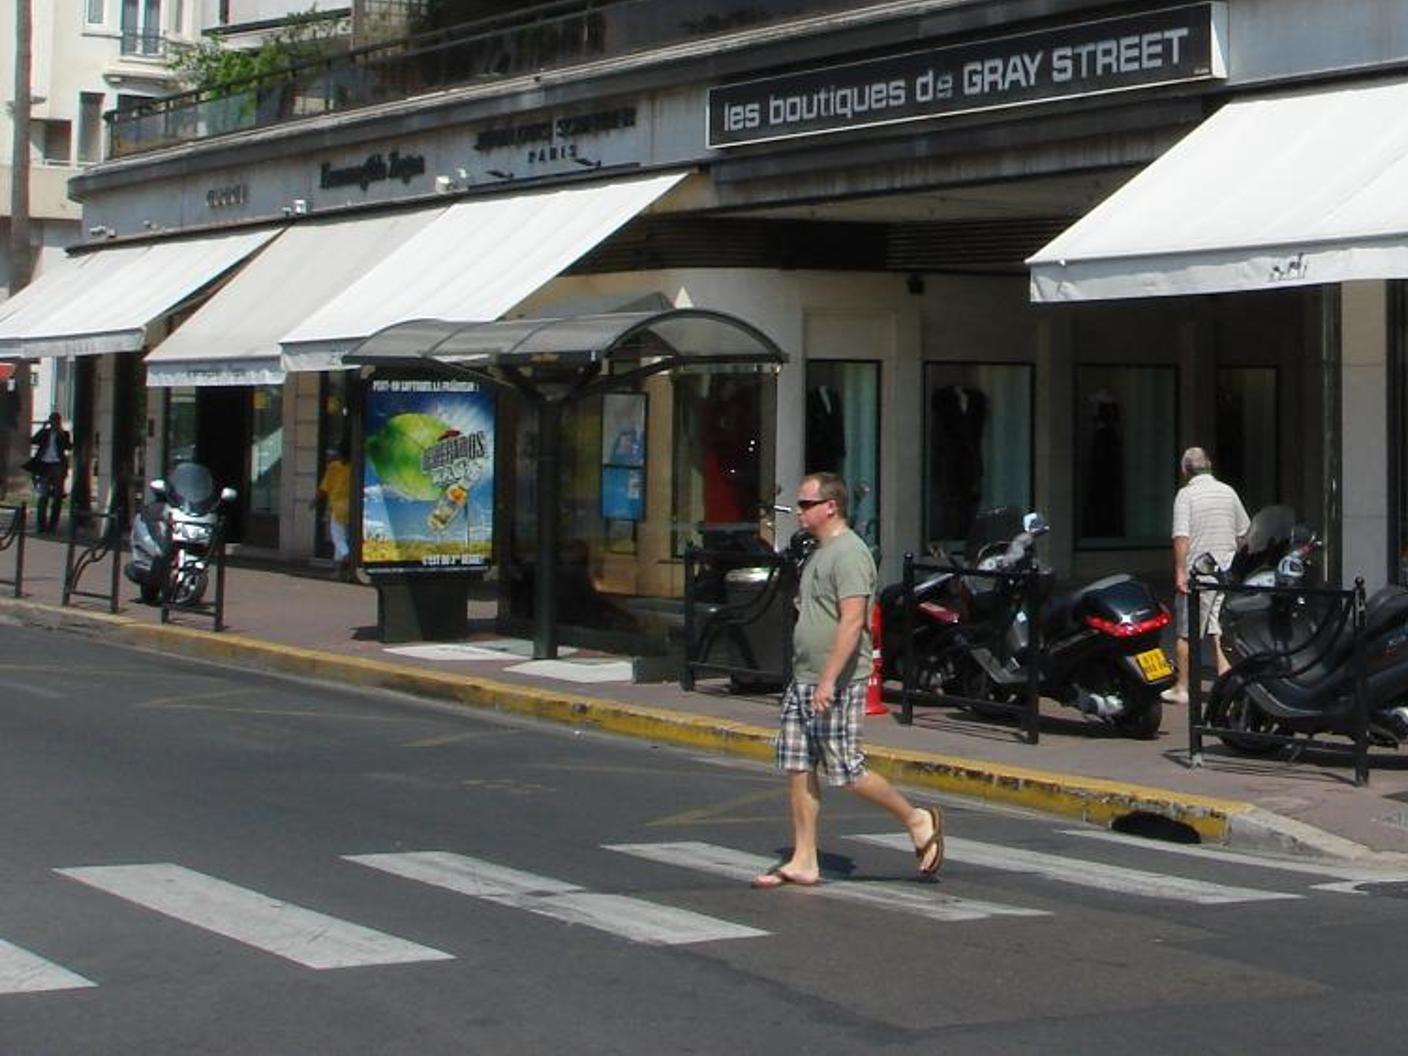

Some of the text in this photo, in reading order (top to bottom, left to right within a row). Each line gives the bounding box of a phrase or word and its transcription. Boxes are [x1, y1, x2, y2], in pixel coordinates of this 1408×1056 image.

[724, 27, 1189, 131] les boutiques de GRAY STREET
